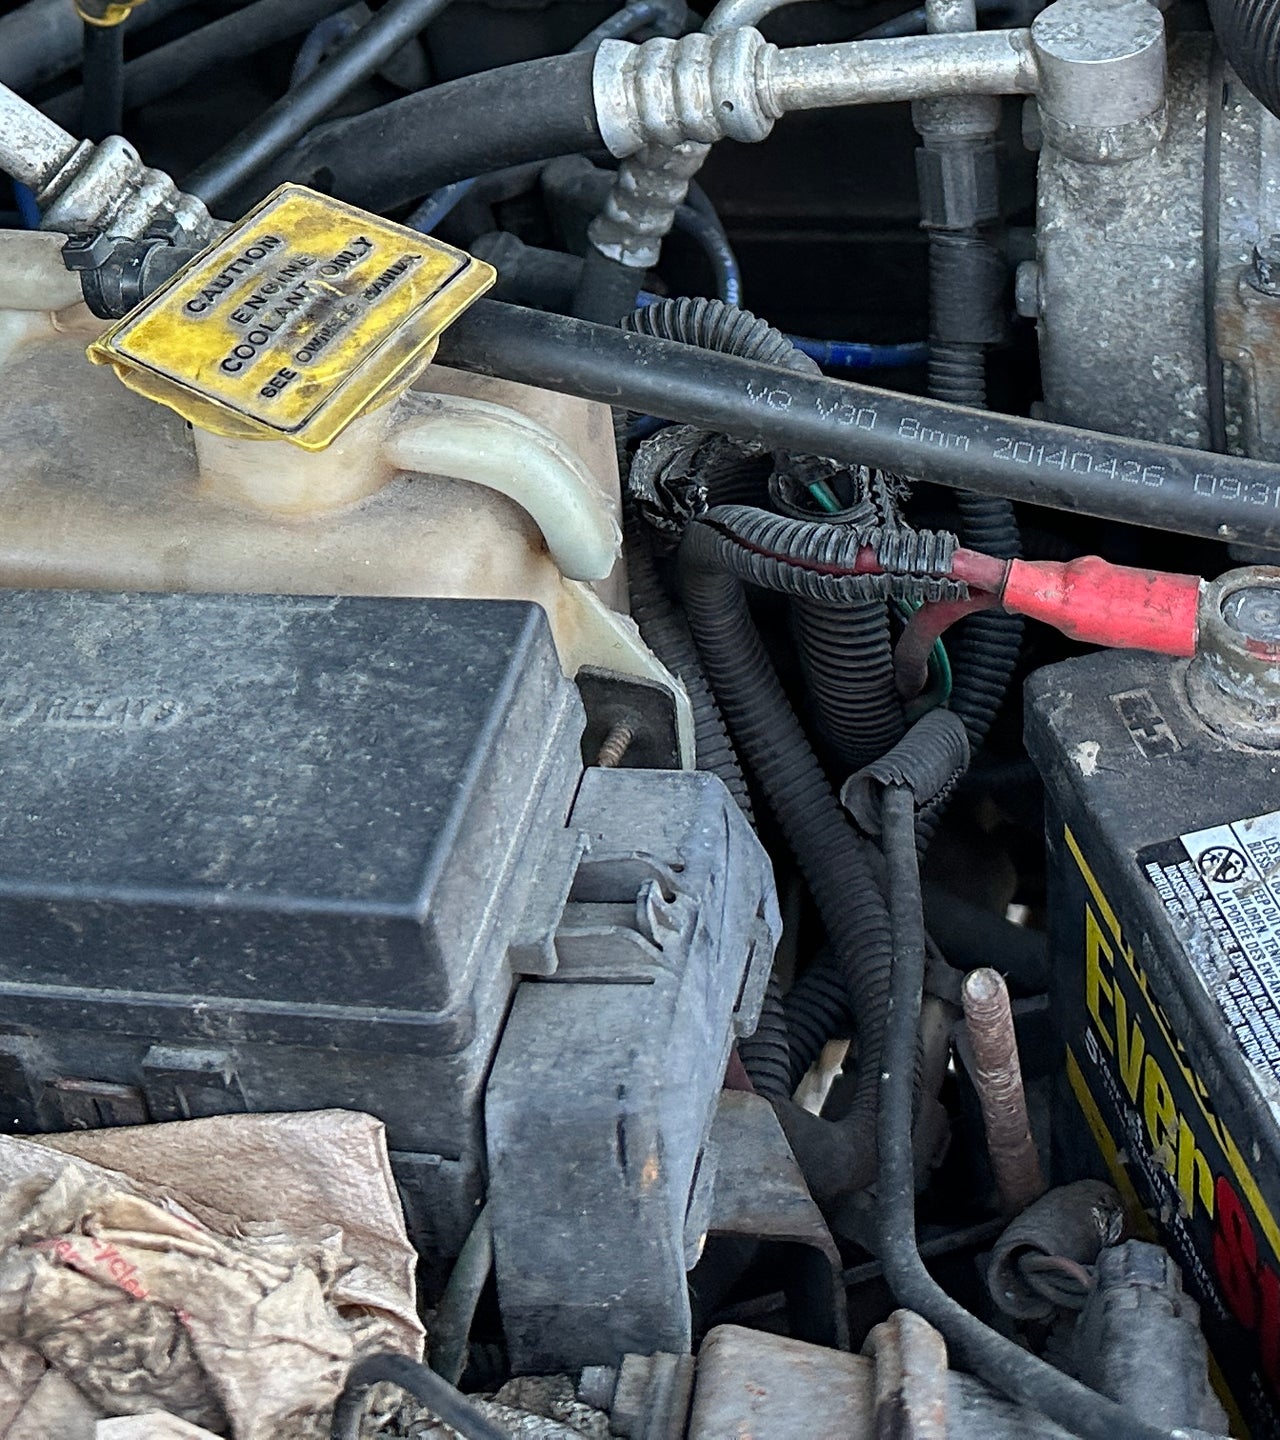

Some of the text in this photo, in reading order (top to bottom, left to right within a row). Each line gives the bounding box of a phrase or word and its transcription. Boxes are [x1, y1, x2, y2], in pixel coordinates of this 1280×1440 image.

[185, 234, 283, 313] CAUTION
[220, 235, 375, 375] COOLANT ONLY
[229, 255, 320, 325] ENGINE
[259, 366, 297, 399] SEE
[898, 417, 969, 452] 8mm
[992, 436, 1165, 488] 20140426
[1194, 472, 1280, 508] 09:31
[1143, 861, 1176, 899] INVERTED
[1214, 890, 1235, 905] LA
[1243, 940, 1268, 962] DES
[1227, 951, 1265, 996] EXPLOSION
